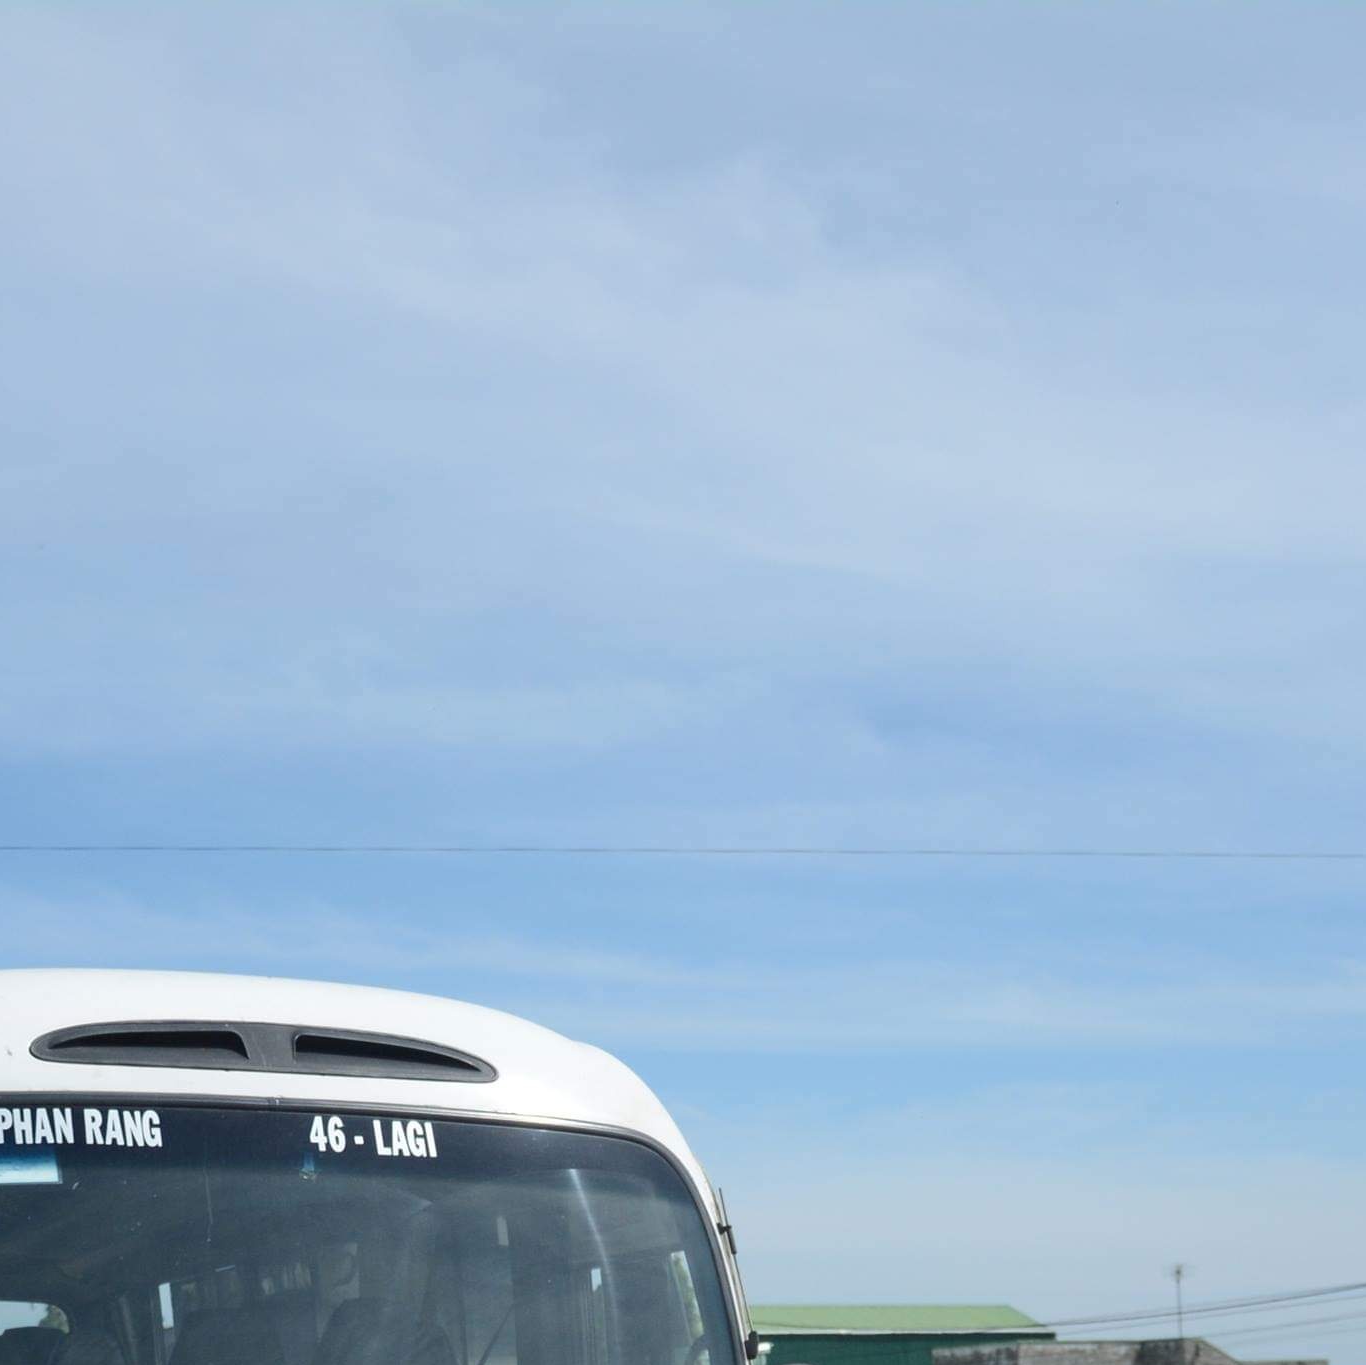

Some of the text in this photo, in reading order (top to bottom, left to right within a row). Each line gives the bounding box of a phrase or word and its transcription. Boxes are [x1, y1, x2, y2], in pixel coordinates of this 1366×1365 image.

[83, 1108, 163, 1148] RANG
[309, 1115, 346, 1153] 46
[372, 1119, 438, 1159] LAGI
